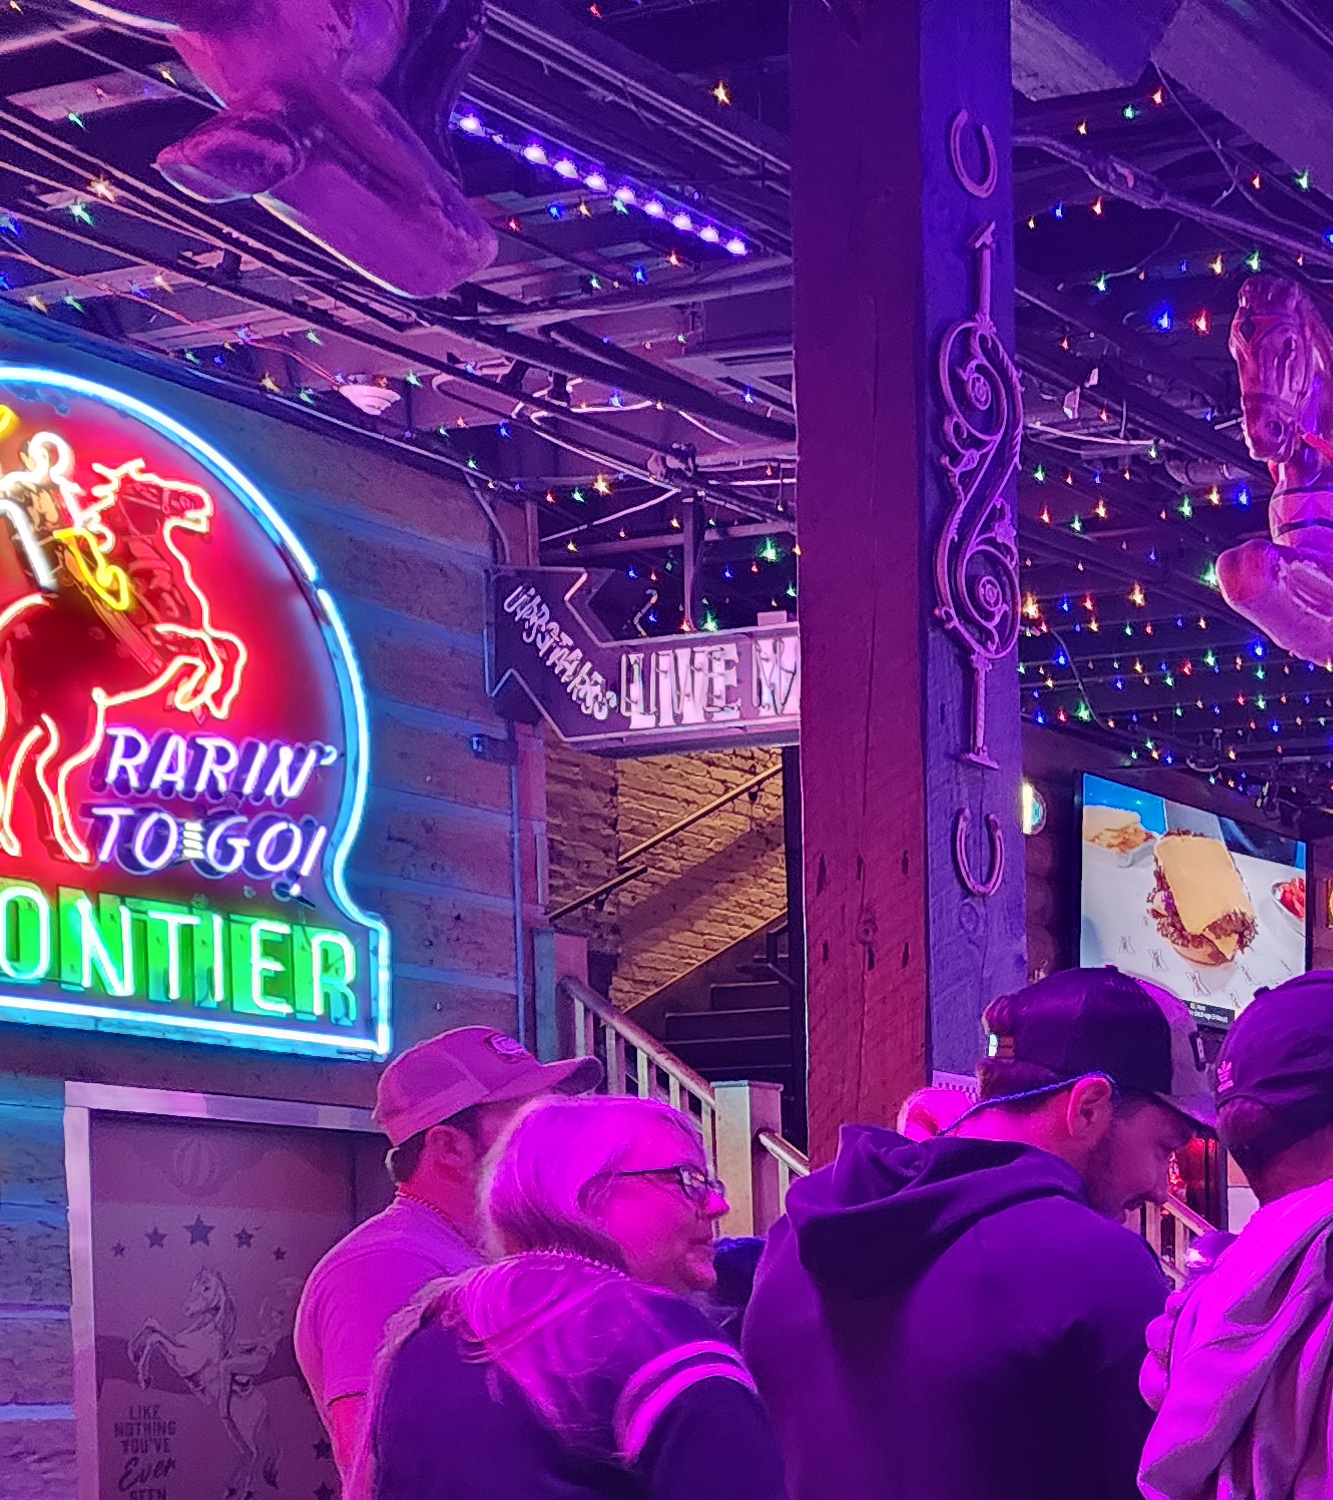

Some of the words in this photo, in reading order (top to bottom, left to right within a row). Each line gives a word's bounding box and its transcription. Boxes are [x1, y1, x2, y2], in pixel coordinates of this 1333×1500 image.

[621, 643, 742, 729] LIVE
[98, 726, 338, 801] RARIN'
[91, 805, 178, 872] TO
[203, 814, 328, 896] GO!
[113, 1420, 177, 1437] NOTHING
[128, 1404, 162, 1420] LIKE
[117, 1456, 177, 1492] Ever
